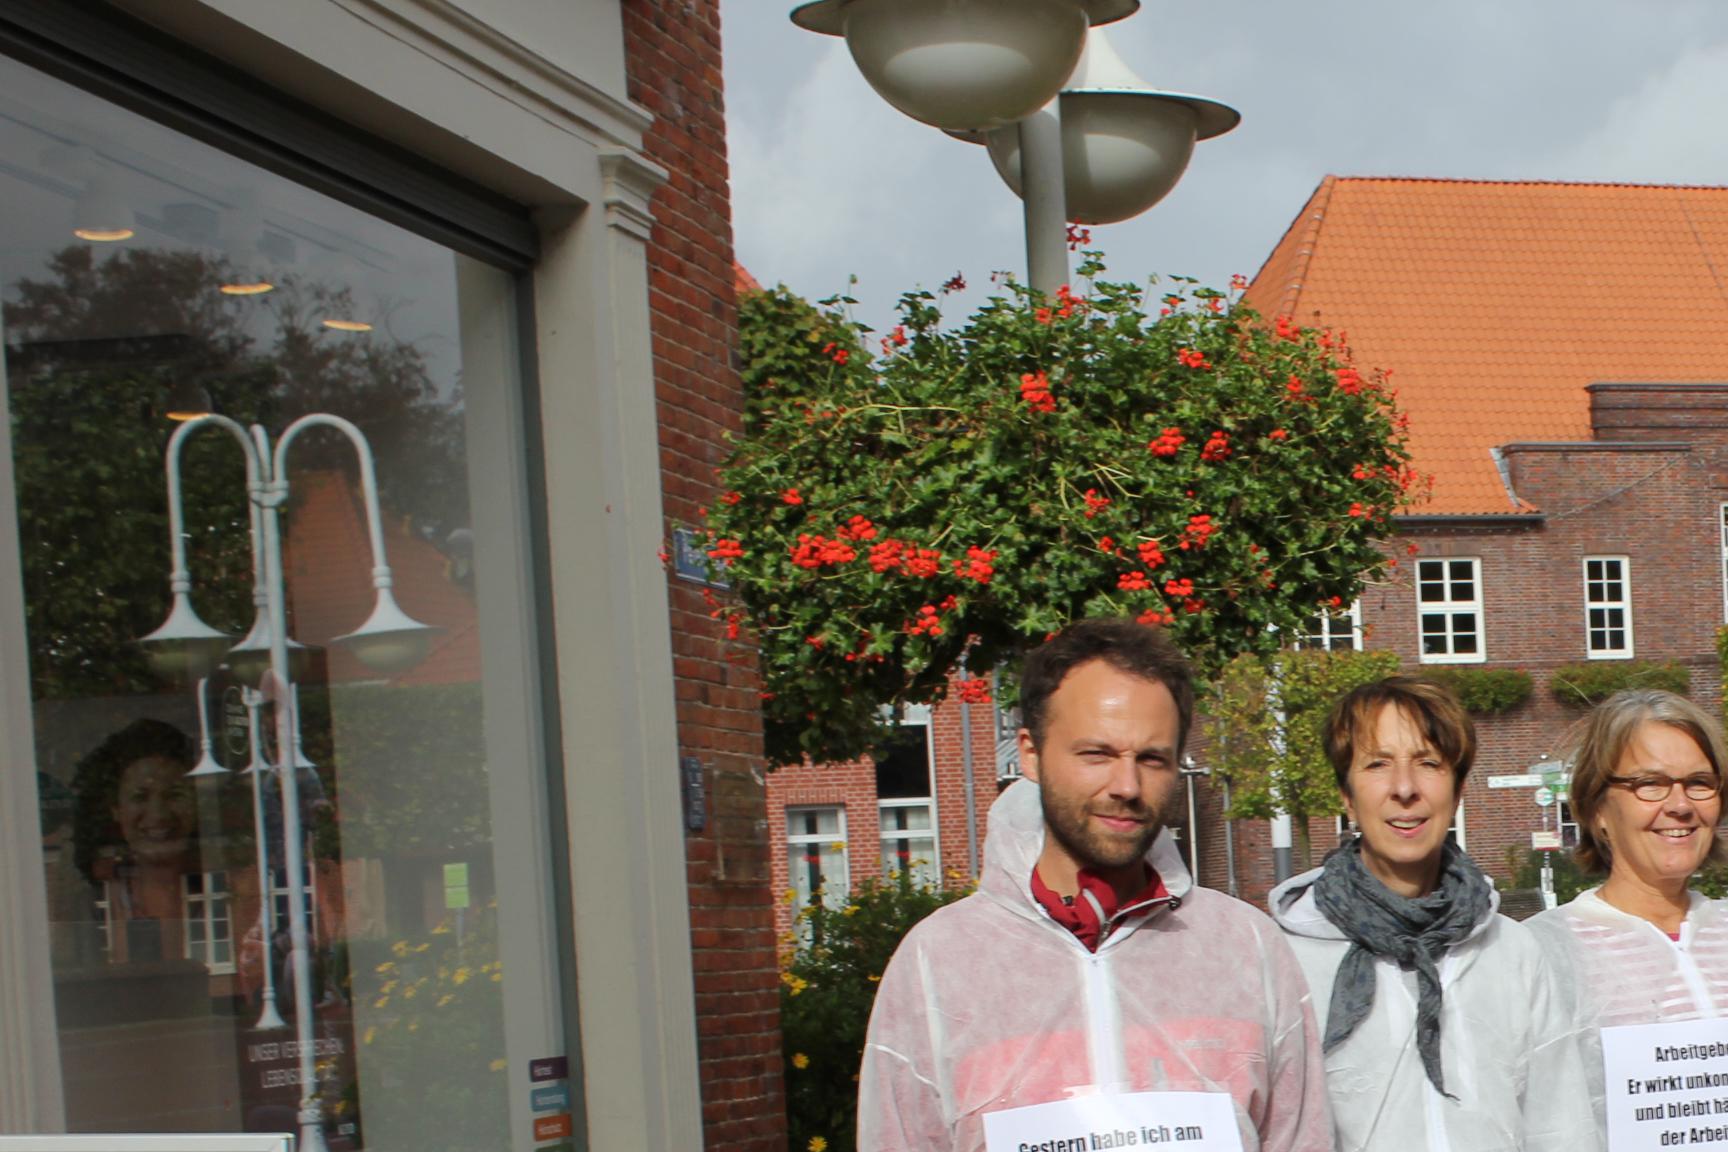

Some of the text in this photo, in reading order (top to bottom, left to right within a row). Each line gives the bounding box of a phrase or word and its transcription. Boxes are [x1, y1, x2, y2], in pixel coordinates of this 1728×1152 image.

[1627, 1079, 1641, 1095] Er
[1645, 1075, 1683, 1093] wirkt
[1635, 1104, 1664, 1121] und
[1668, 1100, 1711, 1119] bleibt
[1091, 1129, 1137, 1150] habe
[1141, 1125, 1171, 1144] ich
[1175, 1125, 1203, 1141] am
[1661, 1130, 1686, 1146] der
